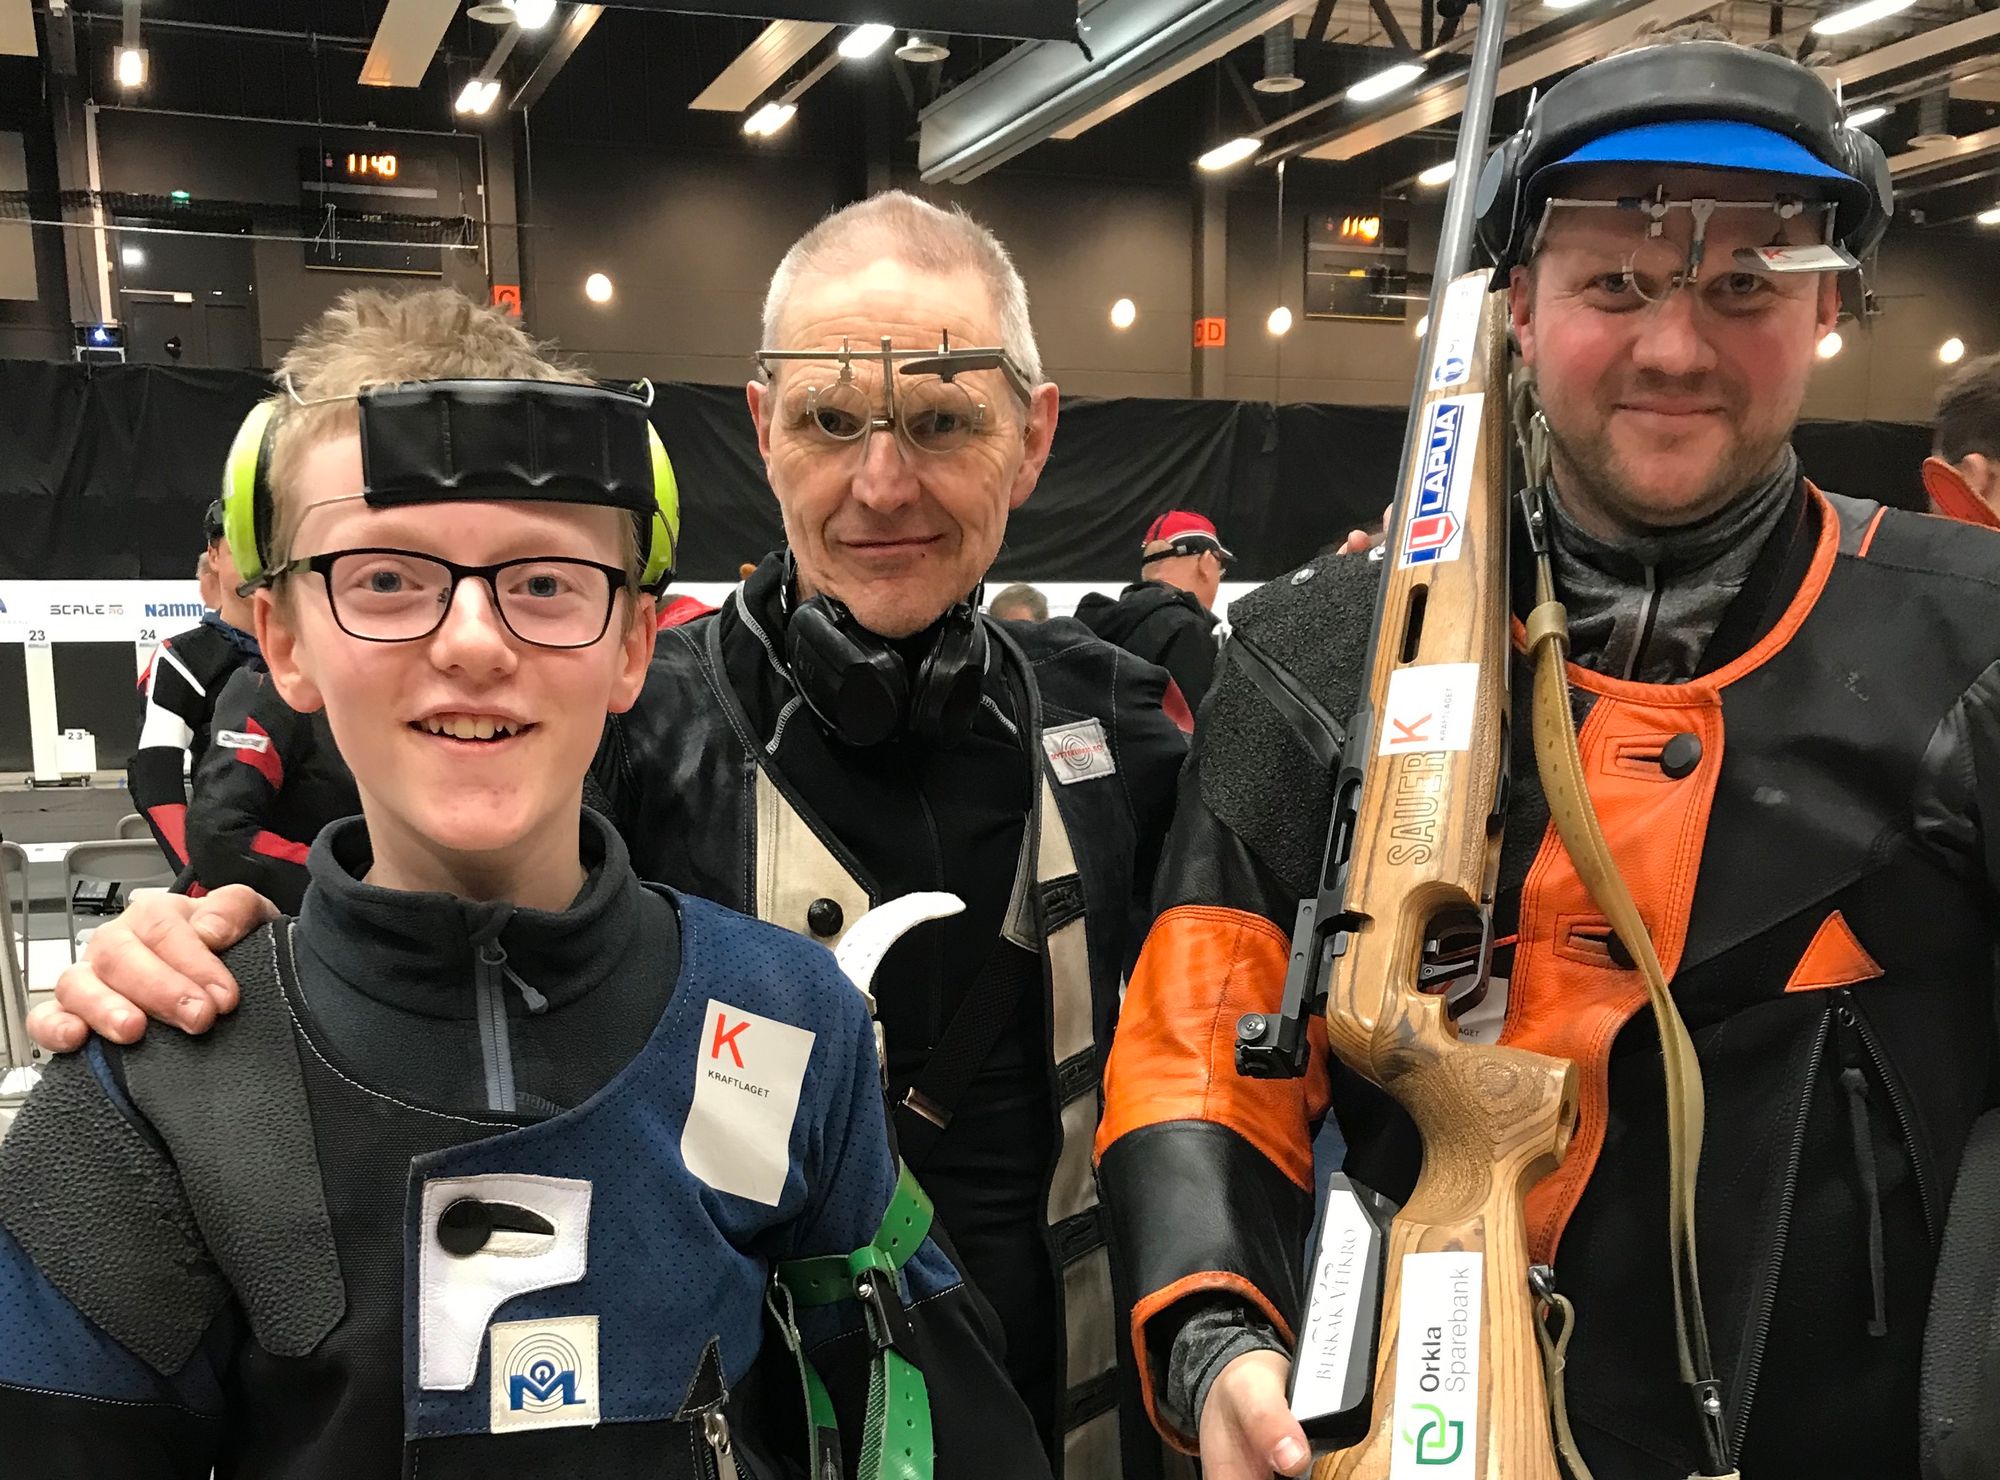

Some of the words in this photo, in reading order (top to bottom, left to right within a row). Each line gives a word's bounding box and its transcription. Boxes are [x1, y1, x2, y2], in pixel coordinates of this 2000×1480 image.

[347, 153, 397, 176] 1140
[1208, 321, 1222, 341] D
[1421, 406, 1459, 513] LAPUA
[50, 604, 105, 615] SCALE
[28, 629, 46, 641] 23
[140, 629, 157, 641] 24
[1390, 713, 1433, 744] K
[711, 1013, 751, 1069] K
[708, 1069, 770, 1098] KRAFTLAGET
[1444, 1267, 1471, 1392] Sparebank
[1419, 1326, 1442, 1393] Orkla
